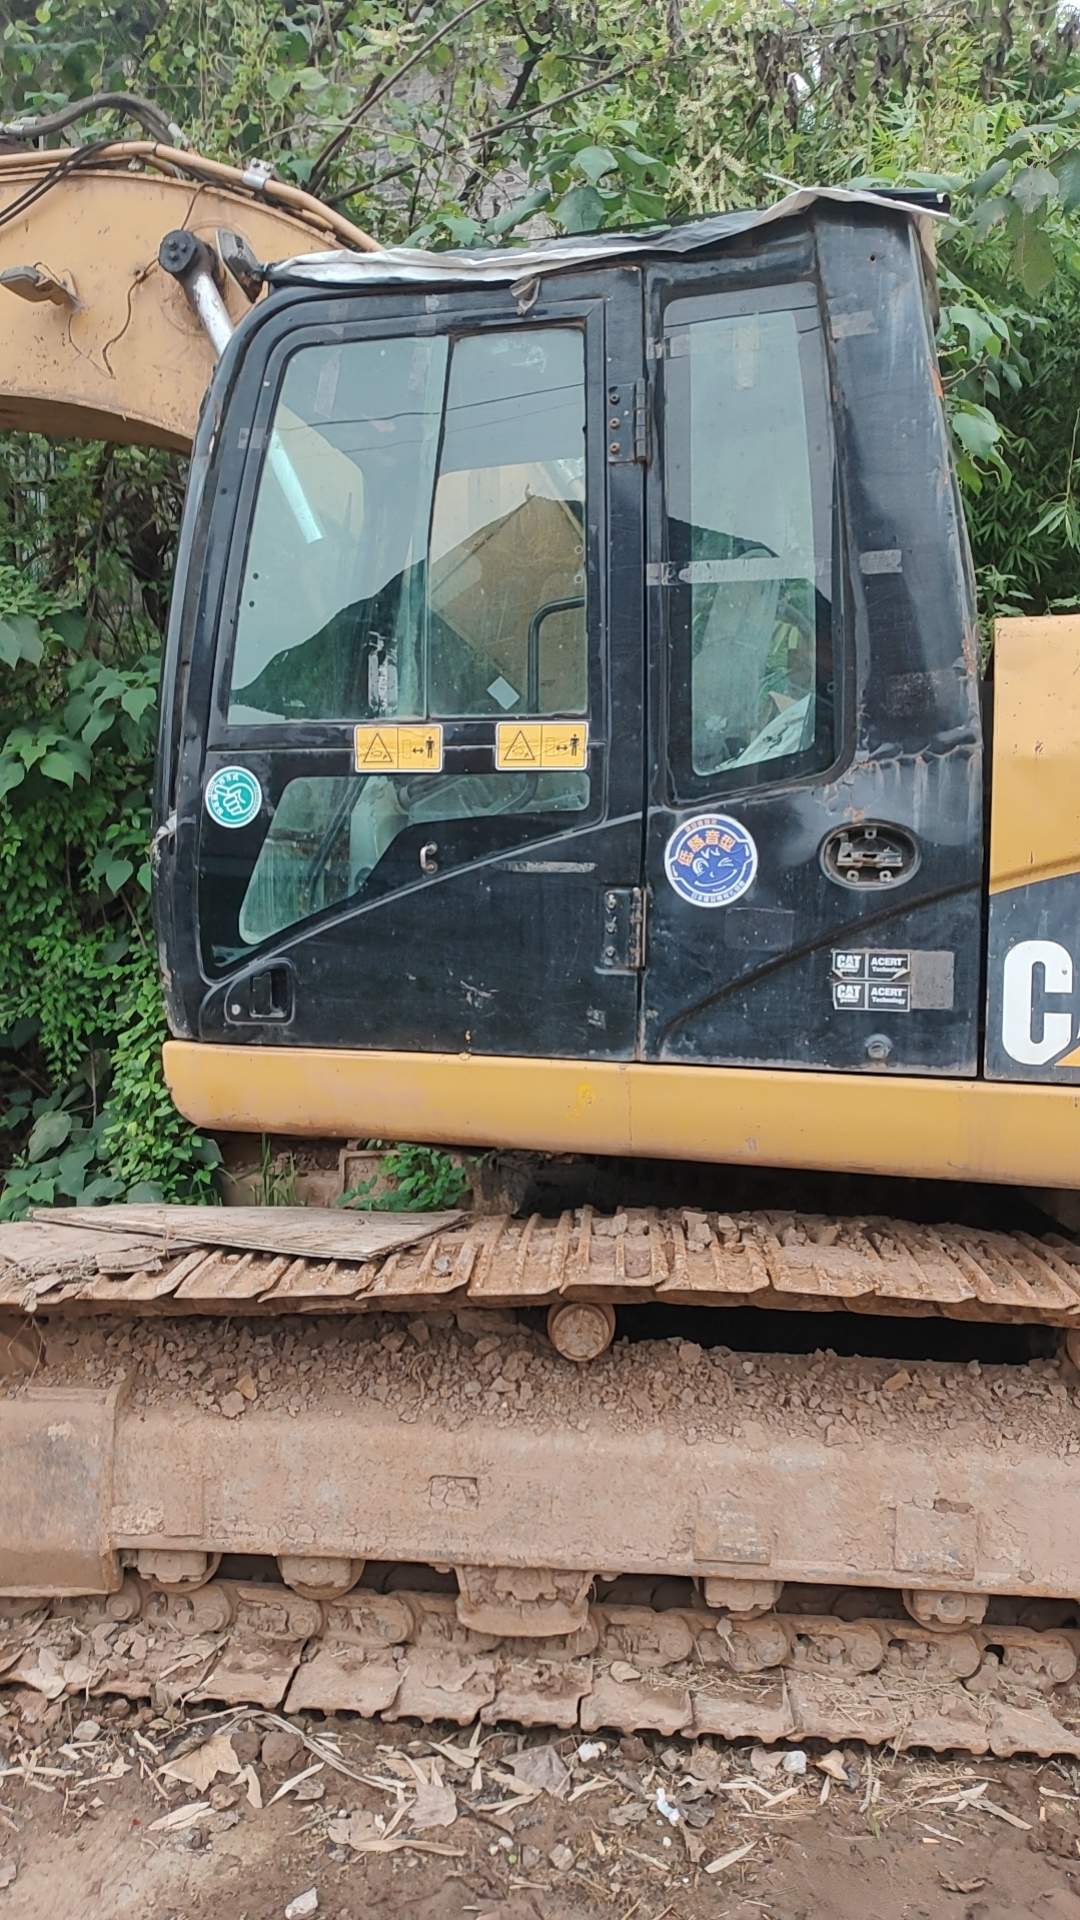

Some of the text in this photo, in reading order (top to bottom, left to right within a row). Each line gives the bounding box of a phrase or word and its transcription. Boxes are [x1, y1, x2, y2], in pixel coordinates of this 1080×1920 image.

[836, 955, 861, 969] CAT
[836, 985, 861, 999] CAT
[1002, 940, 1080, 1066] C
